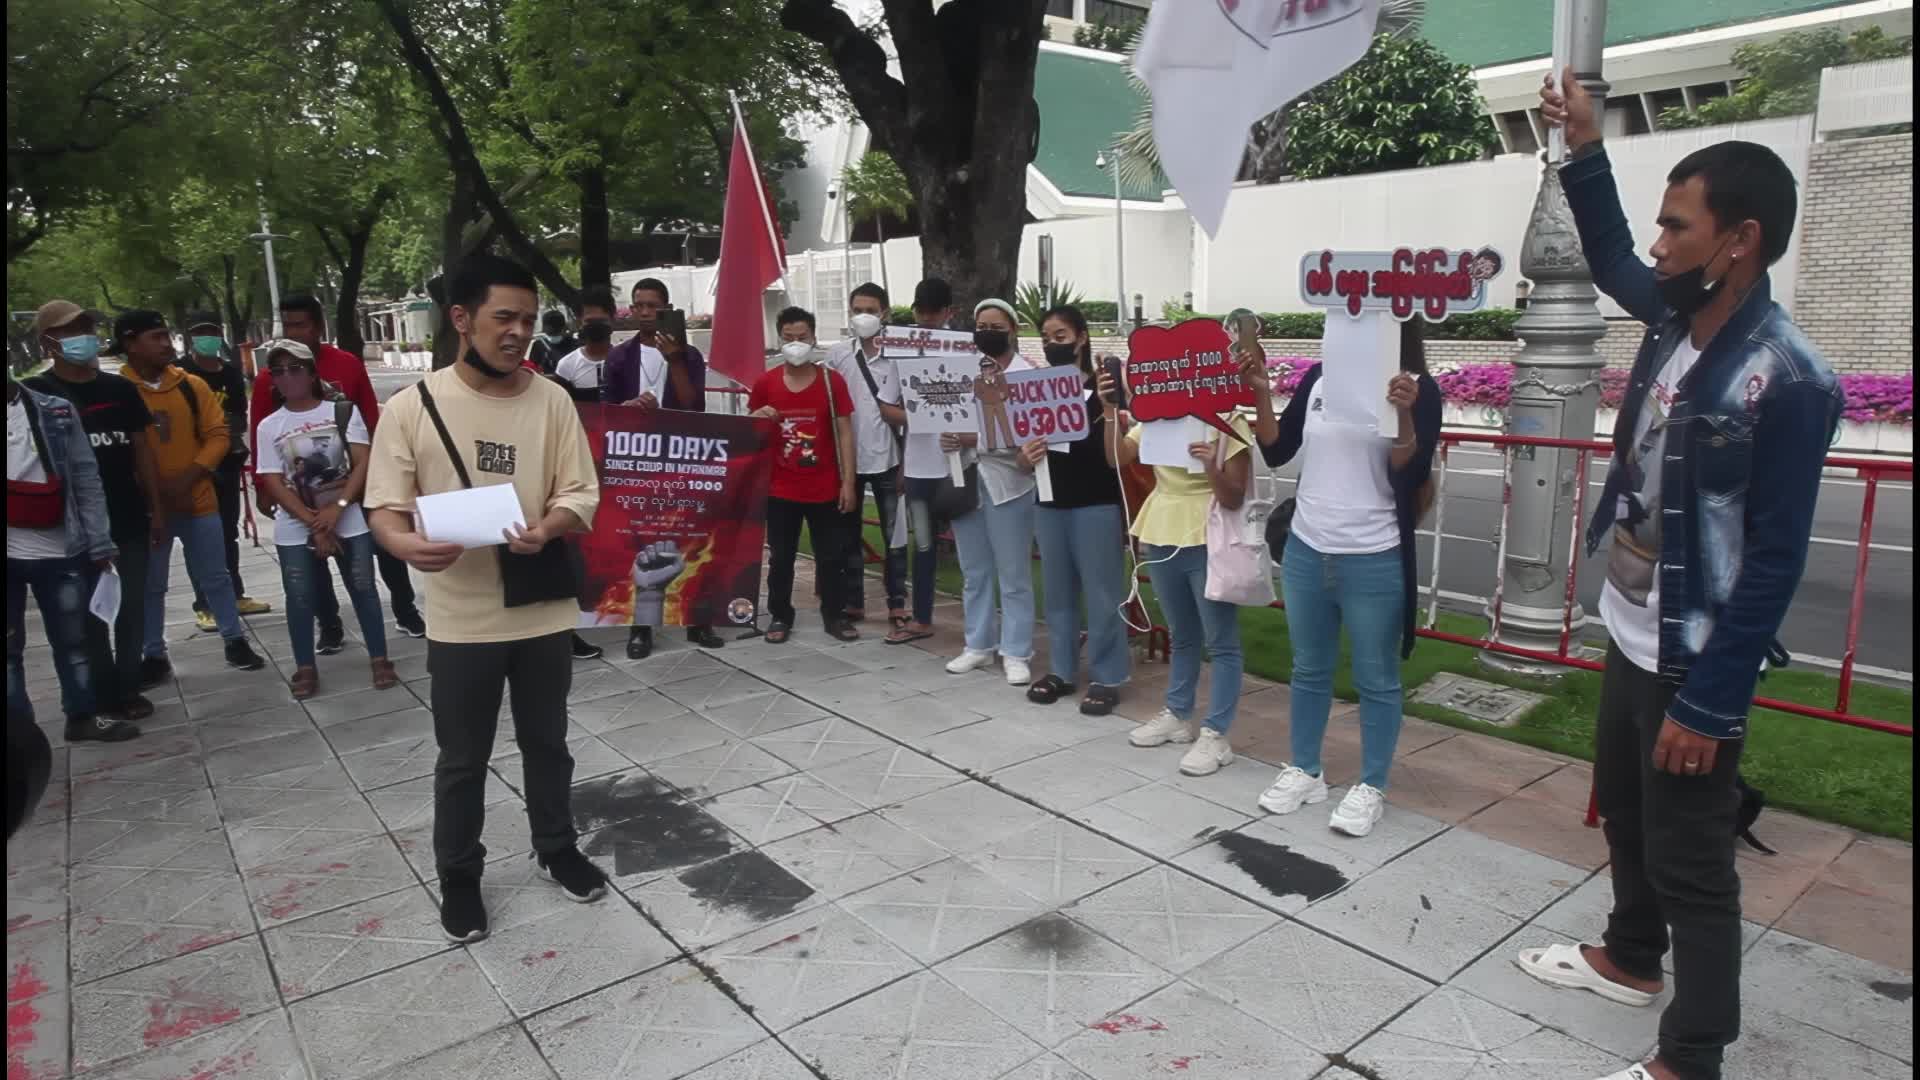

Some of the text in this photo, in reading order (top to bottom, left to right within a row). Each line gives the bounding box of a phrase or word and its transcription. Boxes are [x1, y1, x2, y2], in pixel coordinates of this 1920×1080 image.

[1196, 351, 1222, 367] 1000
[1008, 375, 1081, 405] FUCK YOU
[1013, 403, 1085, 438] မအလ
[605, 431, 729, 462] 1000 DAYS
[605, 460, 727, 476] SINCE COUP IN MYANMAR
[688, 480, 723, 491] 1000
